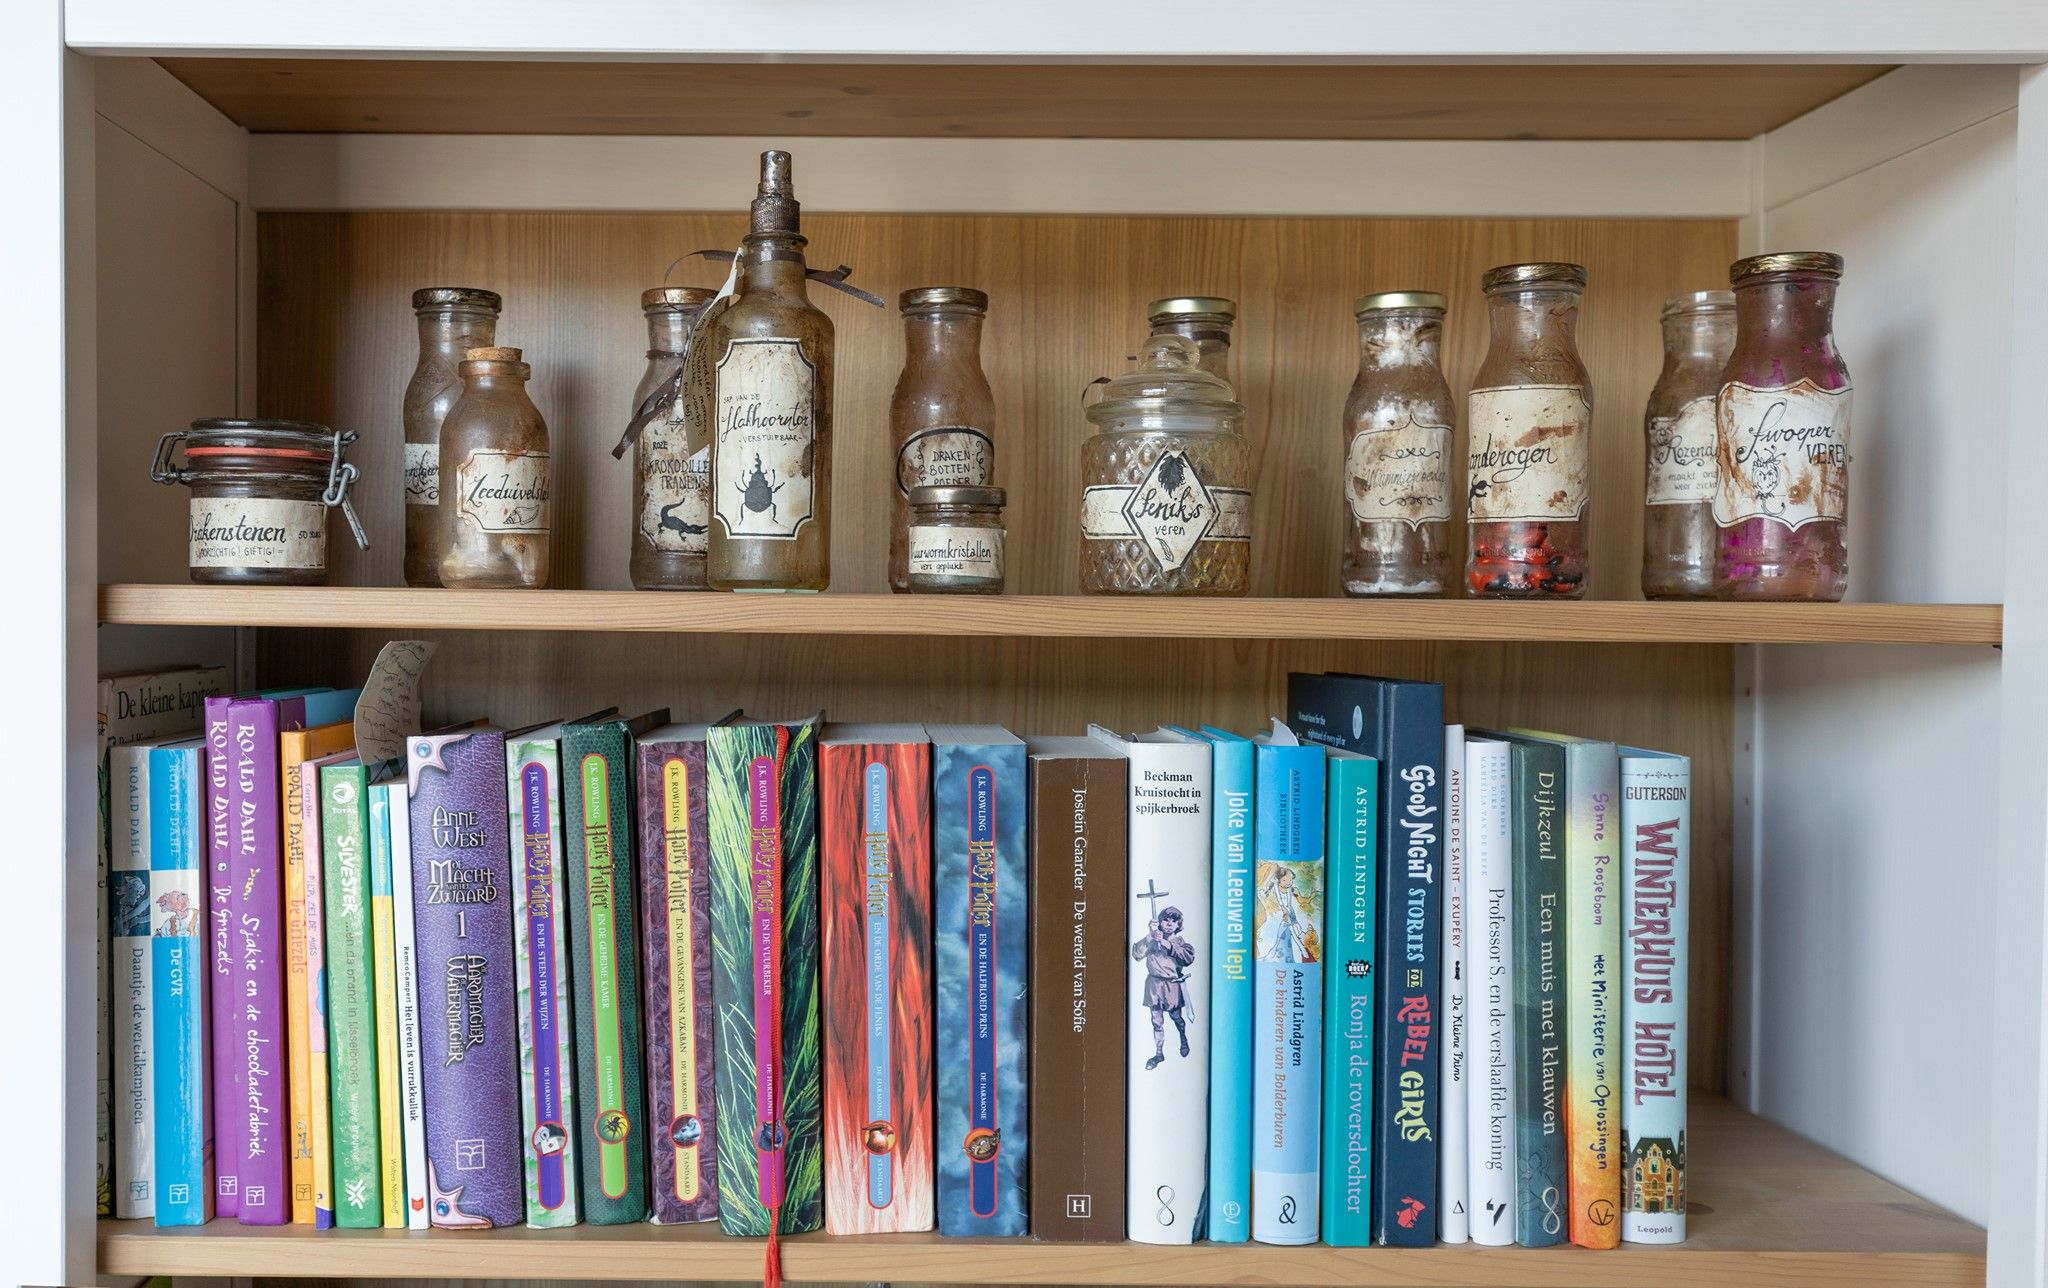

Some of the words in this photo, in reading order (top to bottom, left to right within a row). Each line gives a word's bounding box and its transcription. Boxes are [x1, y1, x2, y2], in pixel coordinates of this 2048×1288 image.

[1155, 525, 1185, 536] veren
[118, 690, 136, 720] De
[140, 687, 175, 716] kleine
[209, 719, 229, 788] ROALD
[236, 723, 256, 793] ROALD
[129, 766, 140, 813] ROALD
[530, 771, 541, 784] J.K.
[1134, 785, 1190, 798] Kruistocht
[1191, 787, 1202, 798] in
[1143, 770, 1193, 782] Beckman
[1293, 770, 1301, 805] ASTRID
[1452, 769, 1460, 819] ANTOINE
[1626, 786, 1688, 801] GUTERSON
[531, 787, 543, 828] ROWLING
[590, 777, 602, 820] ROWLING
[671, 781, 681, 823] ROWLING
[759, 780, 770, 822] ROWLING
[872, 784, 882, 827] ROWLING
[978, 790, 988, 832] ROWLING
[1072, 788, 1087, 833] Jostein
[1135, 803, 1201, 815] spijkerbroek
[1223, 789, 1249, 829] Joke
[1355, 786, 1368, 829] ASTRID
[1533, 771, 1557, 862] Dijkzeul
[1592, 793, 1610, 841] Sanne
[130, 818, 141, 857] DAHL
[170, 816, 181, 857] DAHL
[211, 795, 230, 850] DAHL
[239, 799, 257, 856] DAHL
[585, 822, 611, 862] Harry
[1279, 794, 1288, 856] BIBLIOTHEEK
[1293, 807, 1301, 857] LINDGREN
[1452, 823, 1460, 843] DE
[524, 832, 551, 873] Harry
[665, 827, 689, 868] Harry
[751, 826, 777, 867] Harry
[864, 831, 890, 872] Harry
[968, 838, 995, 880] Harry
[1074, 836, 1087, 891] Gaarder
[1228, 833, 1245, 863] van
[1452, 847, 1461, 883] SAINT
[213, 884, 232, 903] De
[336, 835, 359, 917] SILVESTER
[525, 874, 555, 918] Potter
[588, 862, 615, 909] Potter
[667, 868, 694, 914] Potter
[751, 867, 775, 914] Potter
[864, 871, 894, 918] Potter
[1593, 856, 1610, 926] Rooseboom
[598, 913, 607, 925] EN
[968, 881, 999, 928] Potter
[1074, 902, 1087, 920] De
[1227, 868, 1248, 943] Leeuwen
[1354, 854, 1367, 943] LINDGREN
[1540, 892, 1556, 934] Een
[1628, 817, 1680, 1005] WINTERHUIS
[240, 913, 264, 971] Sjakie
[537, 923, 546, 936] EN
[598, 927, 607, 939] DE
[676, 918, 684, 931] EN
[676, 932, 685, 944] DE
[762, 918, 771, 931] EN
[762, 933, 771, 945] DE
[874, 922, 883, 935] EN
[979, 933, 988, 946] EN
[1406, 887, 1427, 963] STORIES
[1452, 896, 1463, 949] EXUPÉRY
[1489, 889, 1506, 963] Professor
[170, 948, 183, 965] De
[538, 938, 547, 950] DE
[538, 951, 548, 978] STEEN
[599, 940, 609, 979] GEHEIME
[874, 950, 883, 975] ORDE
[979, 947, 988, 960] DE
[1074, 924, 1087, 969] wereld
[129, 948, 145, 1001] Daantje,
[170, 968, 183, 997] GVR
[676, 945, 687, 996] GEVANGENE
[762, 946, 773, 996] VUURBEKER
[874, 975, 883, 991] VAN
[1073, 972, 1084, 998] van
[1275, 969, 1287, 986] De
[1409, 969, 1421, 989] FOR
[1489, 966, 1506, 980] S.
[1541, 941, 1557, 992] muis
[1593, 954, 1606, 977] Het
[246, 979, 258, 998] en
[540, 979, 548, 995] DER
[600, 980, 610, 1009] KAMER
[678, 996, 687, 1013] VAN
[979, 961, 989, 1012] HALFBLOED
[1292, 969, 1305, 1009] Astrid
[1452, 995, 1464, 1011] De
[1489, 986, 1500, 1005] en
[132, 1003, 145, 1018] de
[246, 1004, 261, 1022] de
[404, 1006, 413, 1021] Het
[540, 997, 550, 1031] WIJZEN
[874, 1006, 884, 1038] FENIKS
[979, 1012, 988, 1039] PRINS
[1073, 999, 1087, 1034] Sofie
[1275, 990, 1288, 1042] kinderen
[1344, 994, 1369, 1050] Ronja
[1396, 993, 1431, 1068] REBEL
[1490, 1009, 1506, 1027] de
[1542, 998, 1555, 1040] met
[1592, 980, 1608, 1059] Ministerie
[406, 1023, 414, 1048] leven
[679, 1015, 689, 1053] AZKABAN
[1289, 1011, 1304, 1067] Lindgren
[1452, 1015, 1464, 1049] Kleine
[543, 1066, 551, 1078] DE
[981, 1072, 987, 1082] DE
[1274, 1046, 1285, 1070] van
[1349, 1054, 1369, 1077] de
[1453, 1052, 1465, 1083] Prins
[1490, 1031, 1507, 1112] verslaafde
[1596, 1061, 1605, 1080] van
[1633, 1020, 1677, 1106] HOTEL
[247, 1028, 270, 1160] chocoladefabriek
[407, 1061, 419, 1121] vurrukkulluk
[543, 1079, 552, 1120] HARMONIE
[681, 1072, 690, 1113] HARMONIE
[980, 1083, 988, 1121] HARMONIE
[1273, 1073, 1288, 1149] Bolderburen
[1393, 1070, 1433, 1143] GIRLS
[1542, 1046, 1559, 1136] klauwen
[1485, 1115, 1507, 1171] koning
[1589, 1084, 1611, 1170] Oplossingen
[1347, 1082, 1368, 1215] roversdochter
[1637, 1225, 1674, 1235] Leopold
